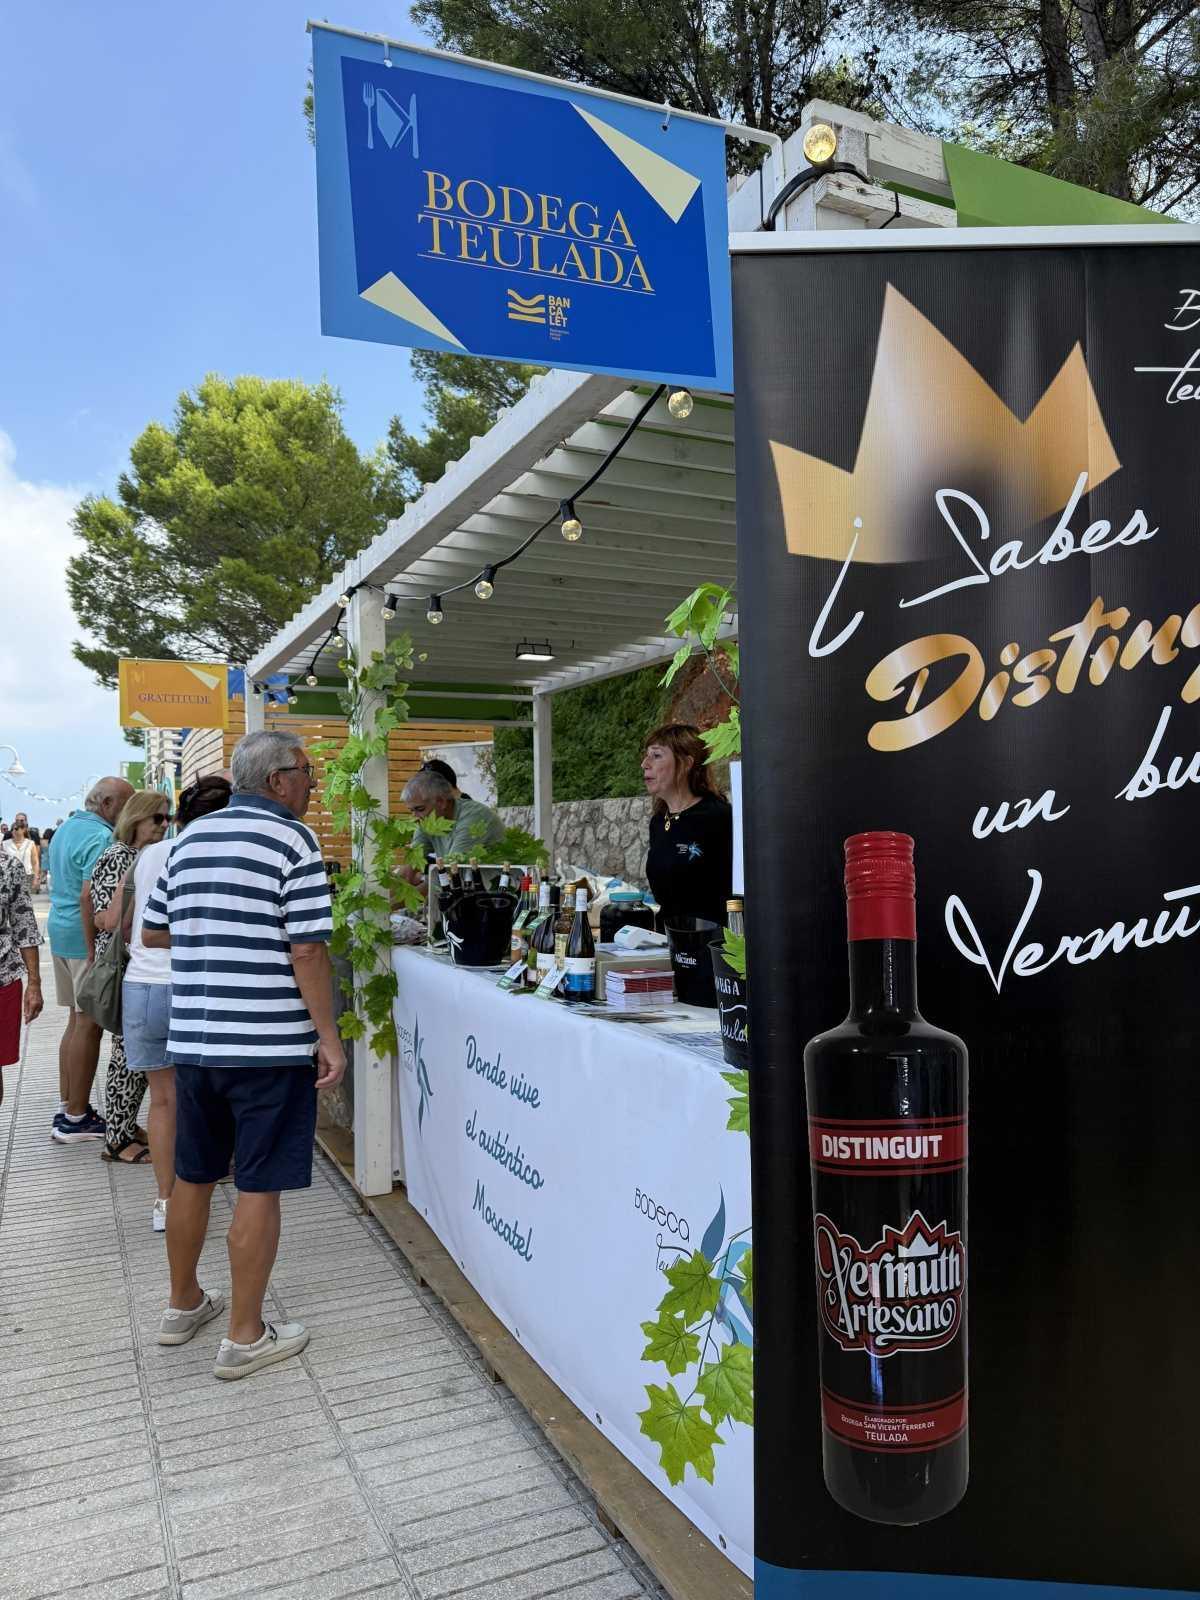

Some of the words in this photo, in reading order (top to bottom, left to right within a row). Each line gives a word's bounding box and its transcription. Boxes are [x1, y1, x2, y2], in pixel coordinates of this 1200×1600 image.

[422, 170, 637, 248] BODEGA
[417, 213, 656, 292] TEULADA
[548, 295, 571, 308] BAN
[549, 305, 564, 318] CA
[549, 315, 568, 327] LET
[138, 692, 211, 705] GRATITUDE
[865, 596, 1200, 752] Distin
[972, 789, 1071, 839] un
[1114, 705, 1200, 801] bu
[944, 868, 1200, 995] Vermu
[465, 1034, 508, 1090] Donde
[510, 1072, 541, 1109] vive
[465, 1109, 478, 1141] el
[478, 1130, 545, 1190] auténtico
[821, 1134, 943, 1160] DISTINGUIT
[472, 1178, 533, 1262] Moscatel
[816, 1225, 961, 1300] Vermuth
[832, 1297, 956, 1346] Artesano
[864, 1430, 909, 1442] TEULADA
